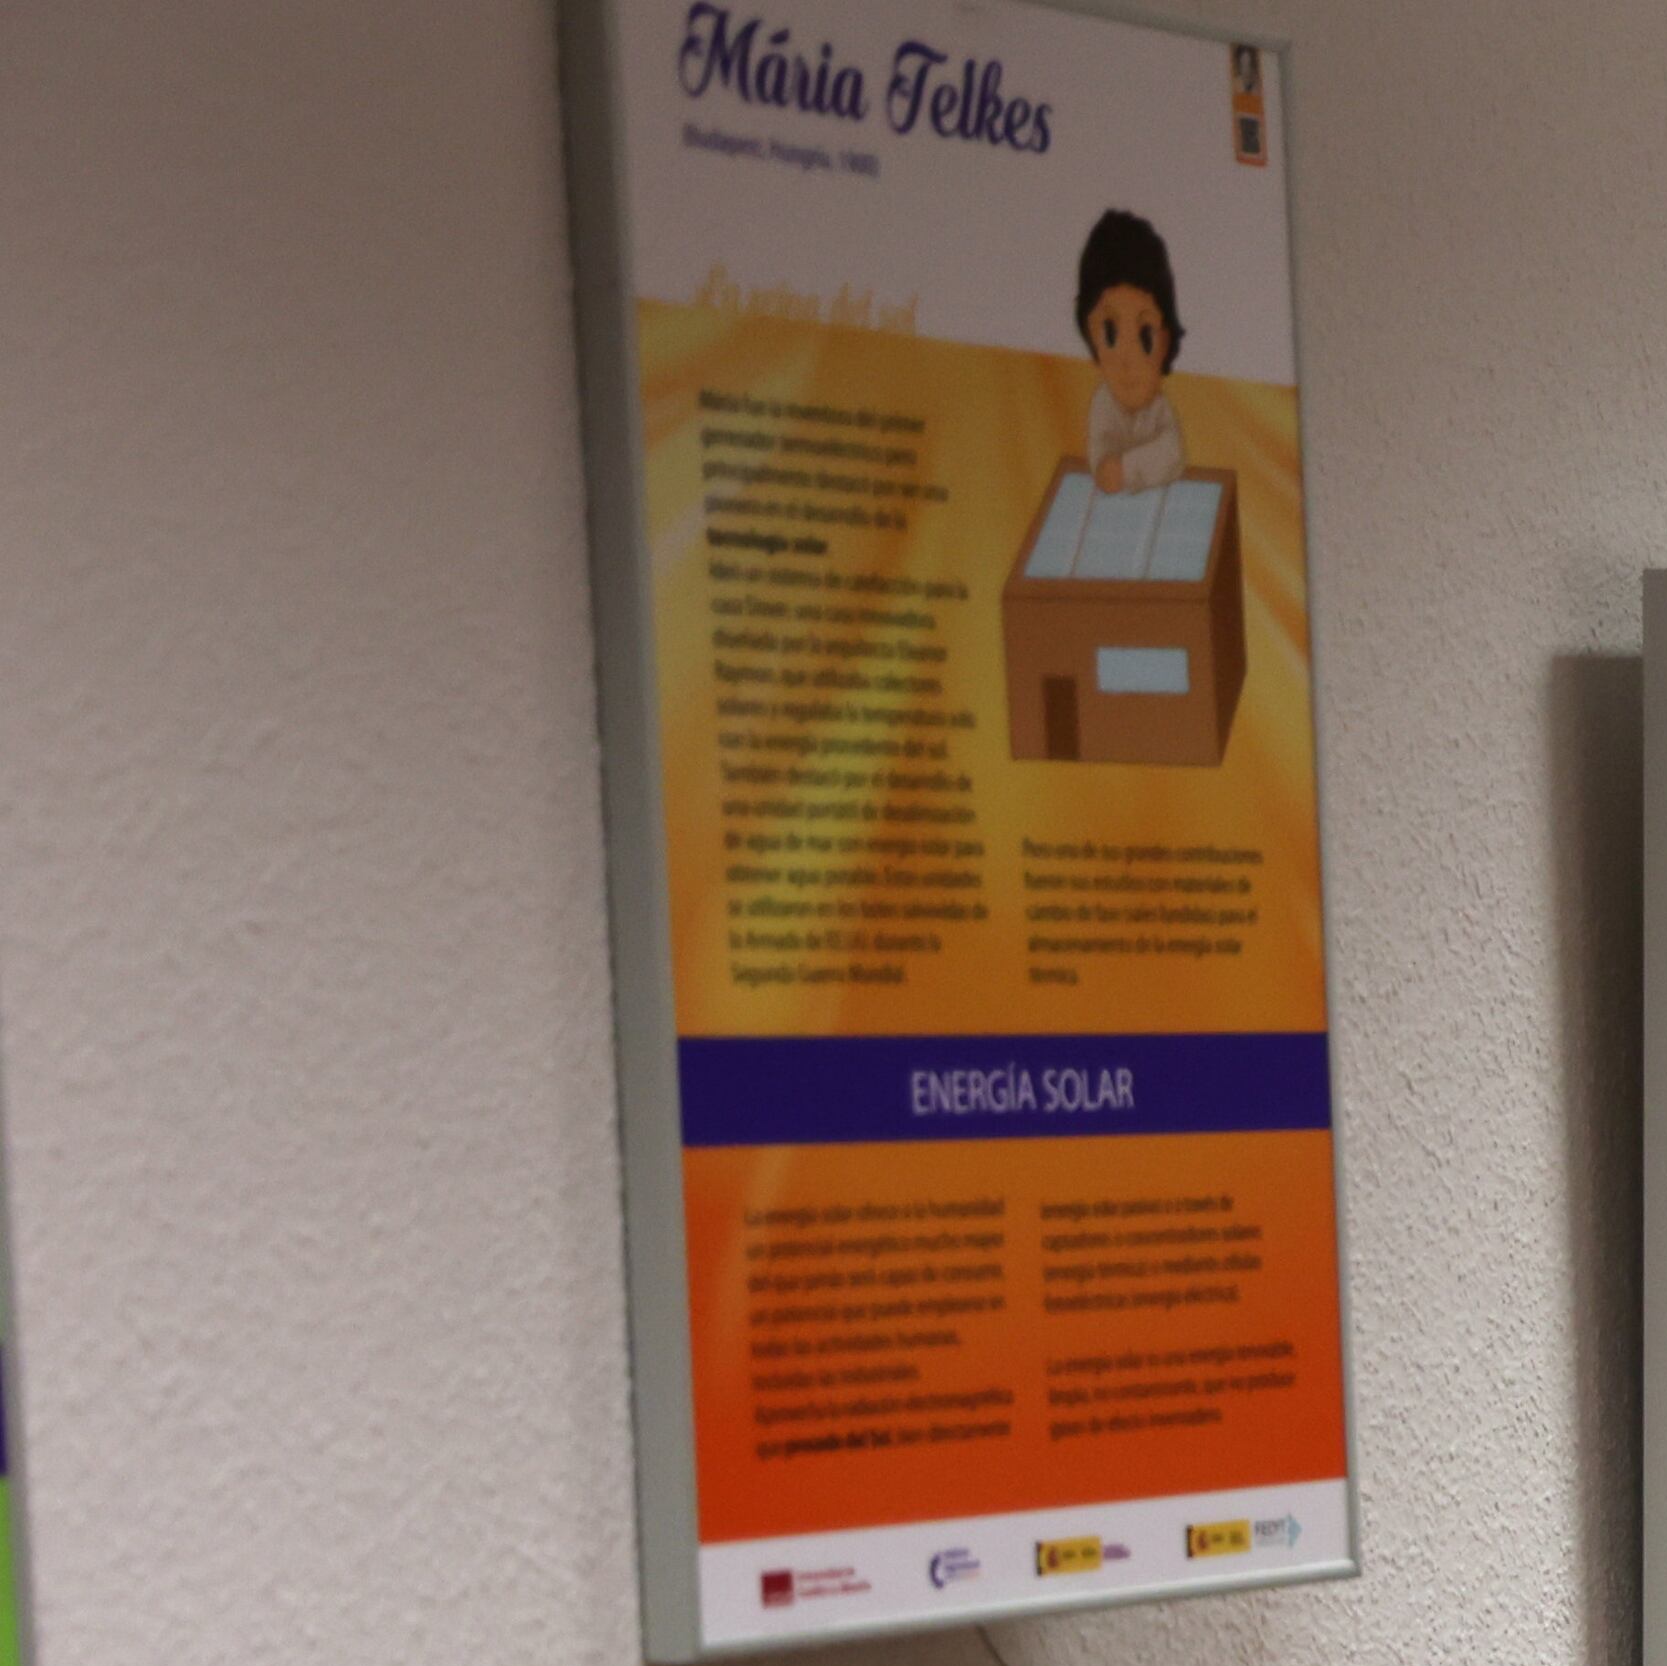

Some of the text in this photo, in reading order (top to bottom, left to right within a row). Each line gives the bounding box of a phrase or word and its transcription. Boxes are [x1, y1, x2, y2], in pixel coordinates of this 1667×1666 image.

[679, 1, 1053, 155] Mária Telkes
[911, 1060, 1135, 1117] ENERGÍA SOLAR
